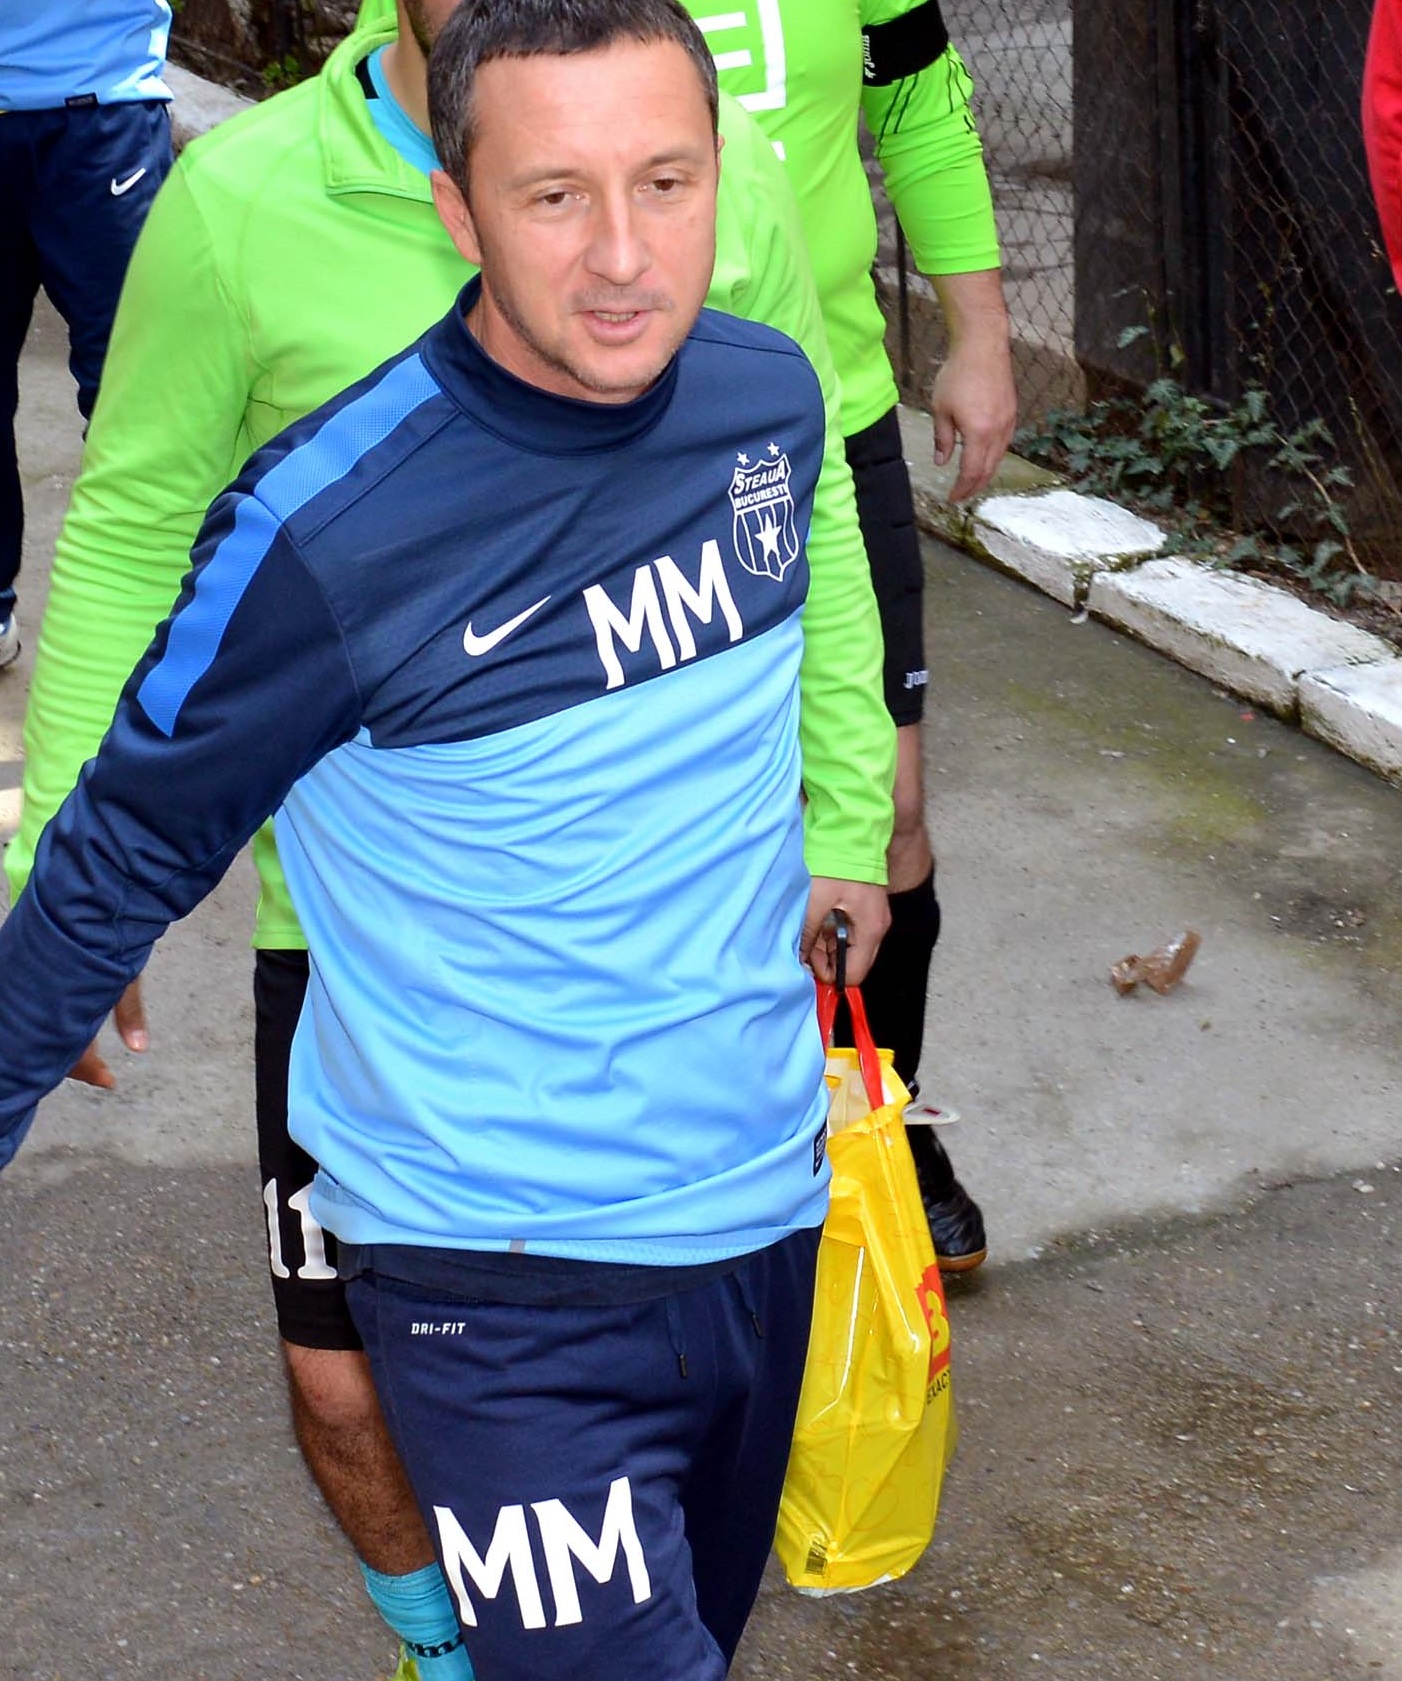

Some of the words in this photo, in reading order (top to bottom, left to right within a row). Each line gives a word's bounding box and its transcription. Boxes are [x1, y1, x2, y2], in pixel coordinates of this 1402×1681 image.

[734, 460, 786, 495] STEAUA
[582, 539, 743, 690] MM
[411, 1322, 467, 1335] DRI-FIT
[433, 1477, 652, 1630] MM
